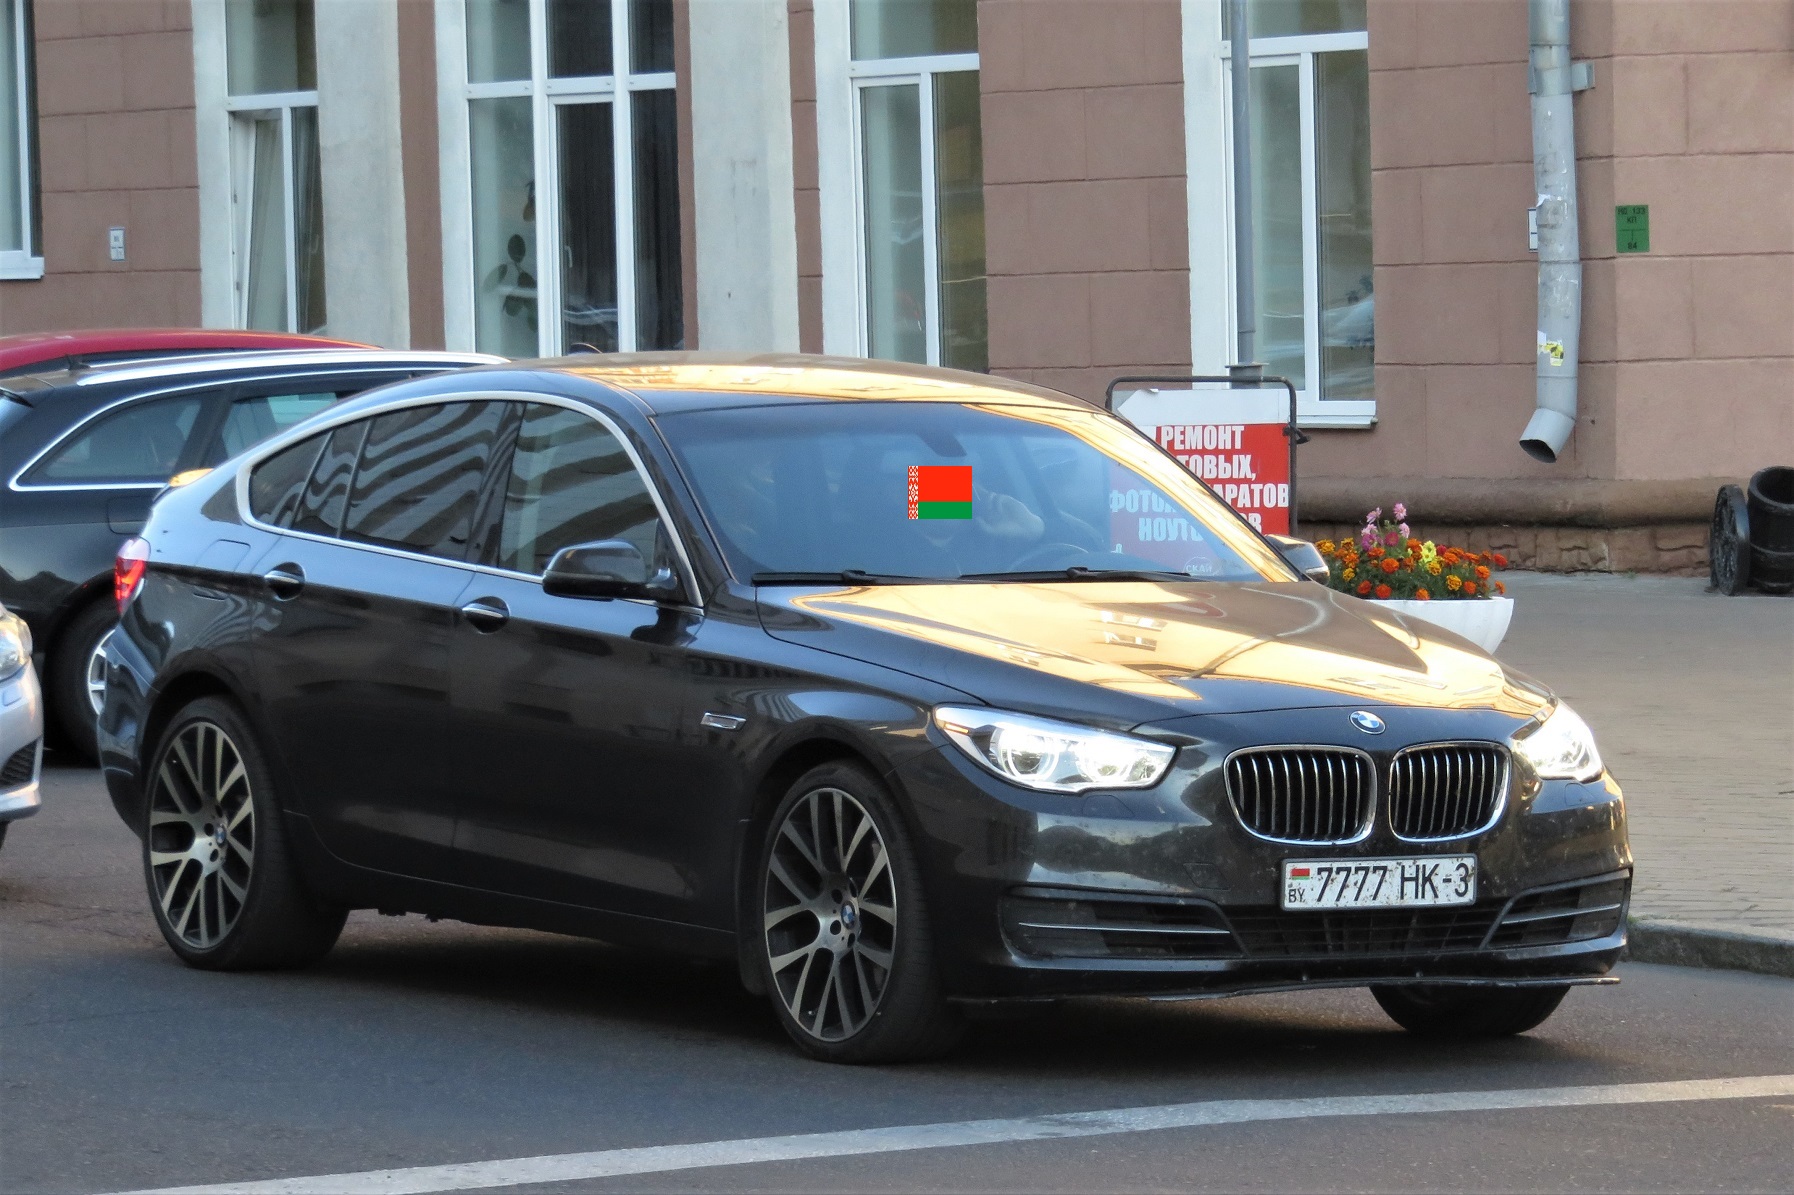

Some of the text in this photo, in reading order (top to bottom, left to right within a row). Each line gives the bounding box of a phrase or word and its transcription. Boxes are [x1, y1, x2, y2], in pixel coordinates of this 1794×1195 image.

[1161, 425, 1245, 450] РЕМОНТ
[1176, 454, 1256, 481] ТОВЫХ,
[1317, 862, 1470, 902] 7777 HK-3
[1288, 888, 1305, 903] BY
